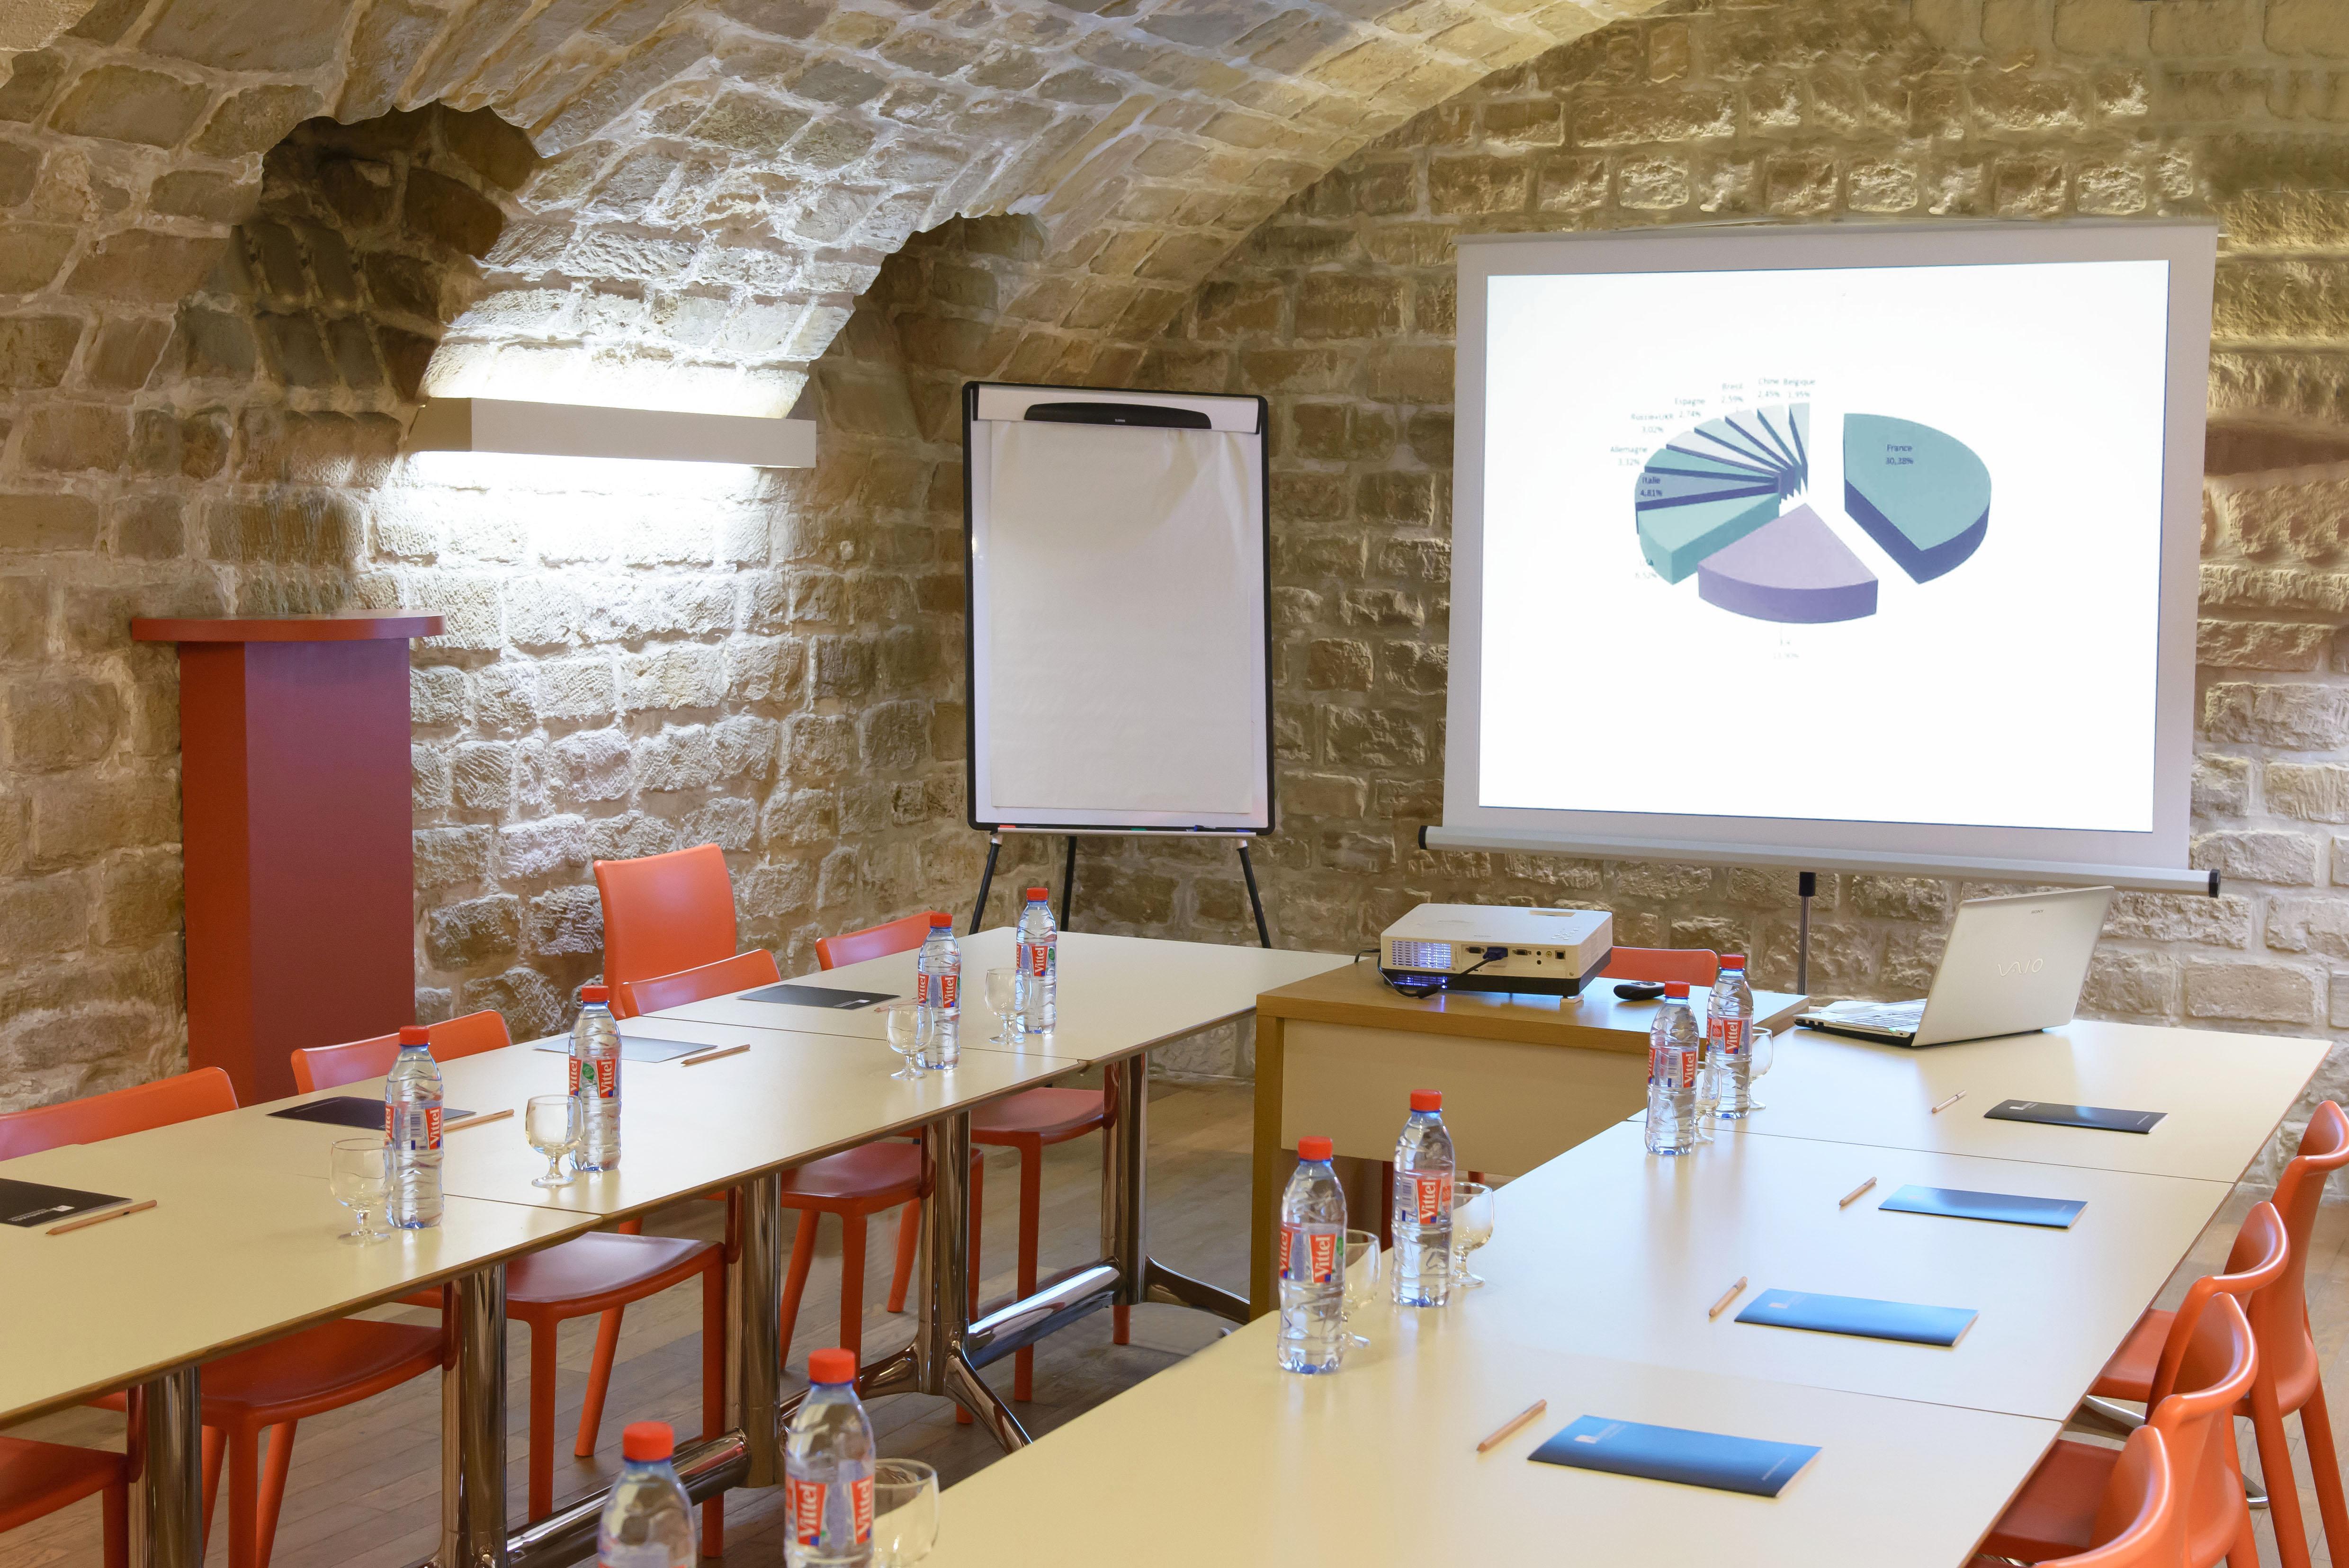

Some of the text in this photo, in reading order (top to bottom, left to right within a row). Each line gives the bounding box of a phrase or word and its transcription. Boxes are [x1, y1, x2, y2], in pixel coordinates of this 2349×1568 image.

[1035, 947, 1045, 974] Vittel
[944, 977, 955, 1005] Vittel
[1726, 1022, 1739, 1051] Vittel
[601, 1061, 612, 1094] Vittel
[1684, 1053, 1695, 1084] Vittel
[430, 1109, 440, 1146] Vittel
[1421, 1179, 1436, 1219] Vittel
[1315, 1236, 1330, 1278] Vittel
[798, 1483, 817, 1537] Vittel
[857, 1479, 871, 1537] Vittel
